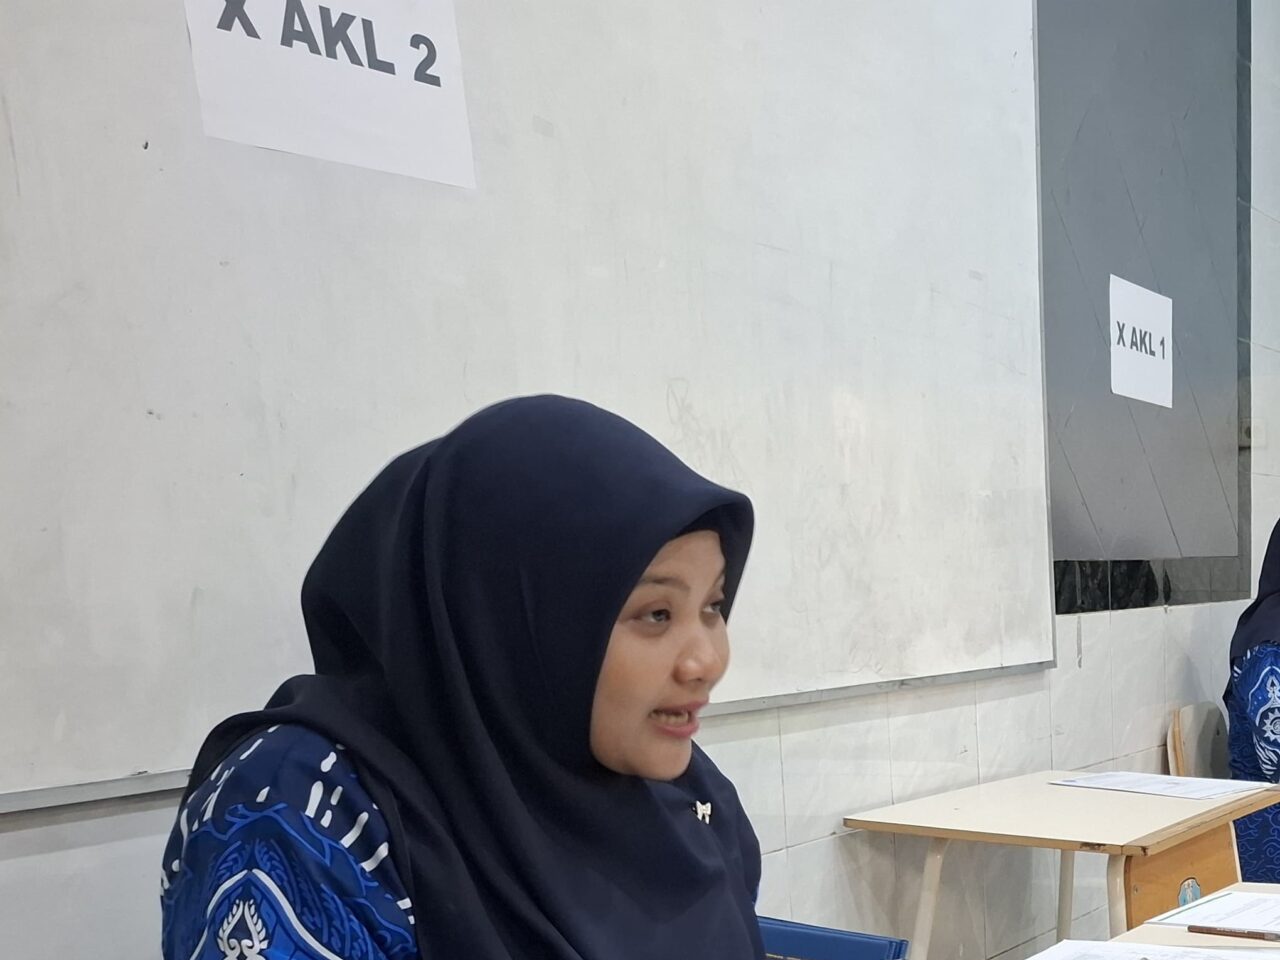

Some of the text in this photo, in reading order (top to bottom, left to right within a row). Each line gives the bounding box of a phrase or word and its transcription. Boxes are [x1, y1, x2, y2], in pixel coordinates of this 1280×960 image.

[217, 0, 442, 88] X AKL 2
[1116, 320, 1165, 360] X AKL 1
